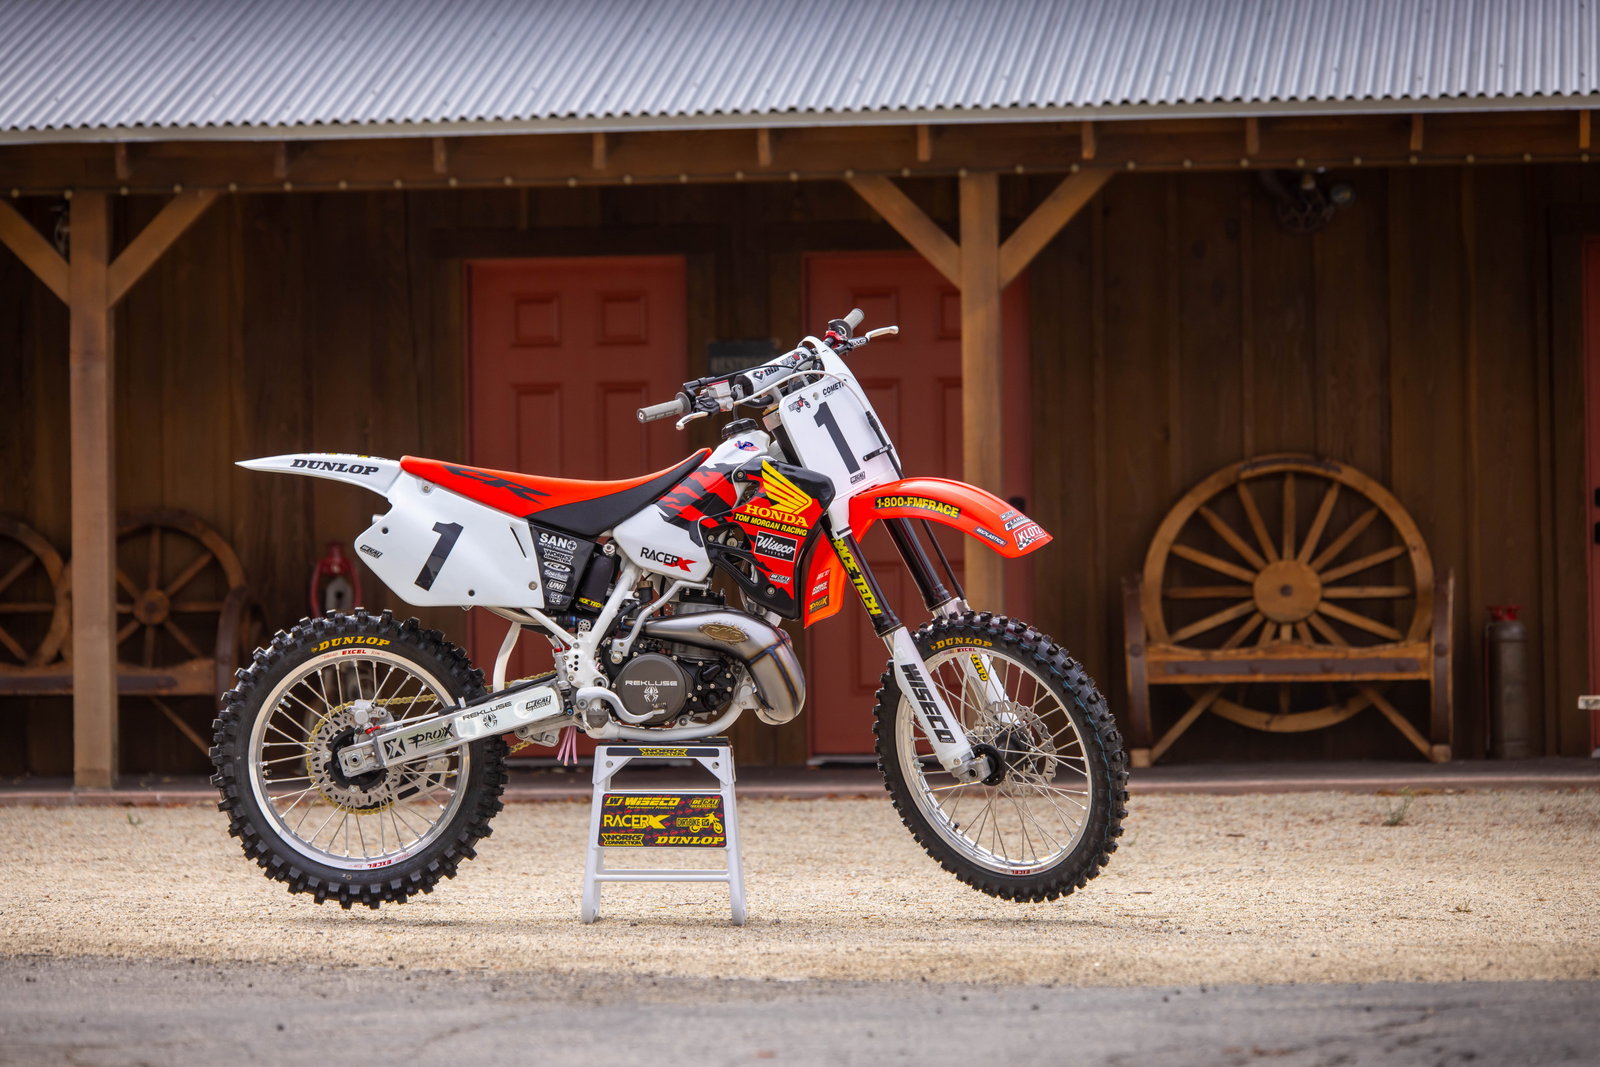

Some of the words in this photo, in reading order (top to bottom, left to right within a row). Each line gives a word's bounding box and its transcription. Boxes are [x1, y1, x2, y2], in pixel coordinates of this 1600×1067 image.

[813, 401, 861, 475] 1
[289, 458, 380, 476] DUNLOP
[744, 503, 809, 528] HONDA
[876, 496, 960, 518] 1-800-FMFRACE
[735, 512, 751, 523] TOM
[750, 517, 780, 531] MORGAN
[780, 524, 808, 537] RACING
[1017, 525, 1043, 543] KLOTZ
[757, 535, 797, 554] Wiseco
[414, 521, 464, 592] 1
[853, 574, 882, 615] TECH
[318, 636, 391, 651] DUNLOP
[935, 636, 993, 650] DUNLOP
[462, 701, 512, 720] REKLUSE
[900, 663, 956, 741] WISECO
[624, 797, 681, 806] WISECO
[655, 836, 725, 845] DUNLOP
[368, 859, 392, 869] EXCEL
